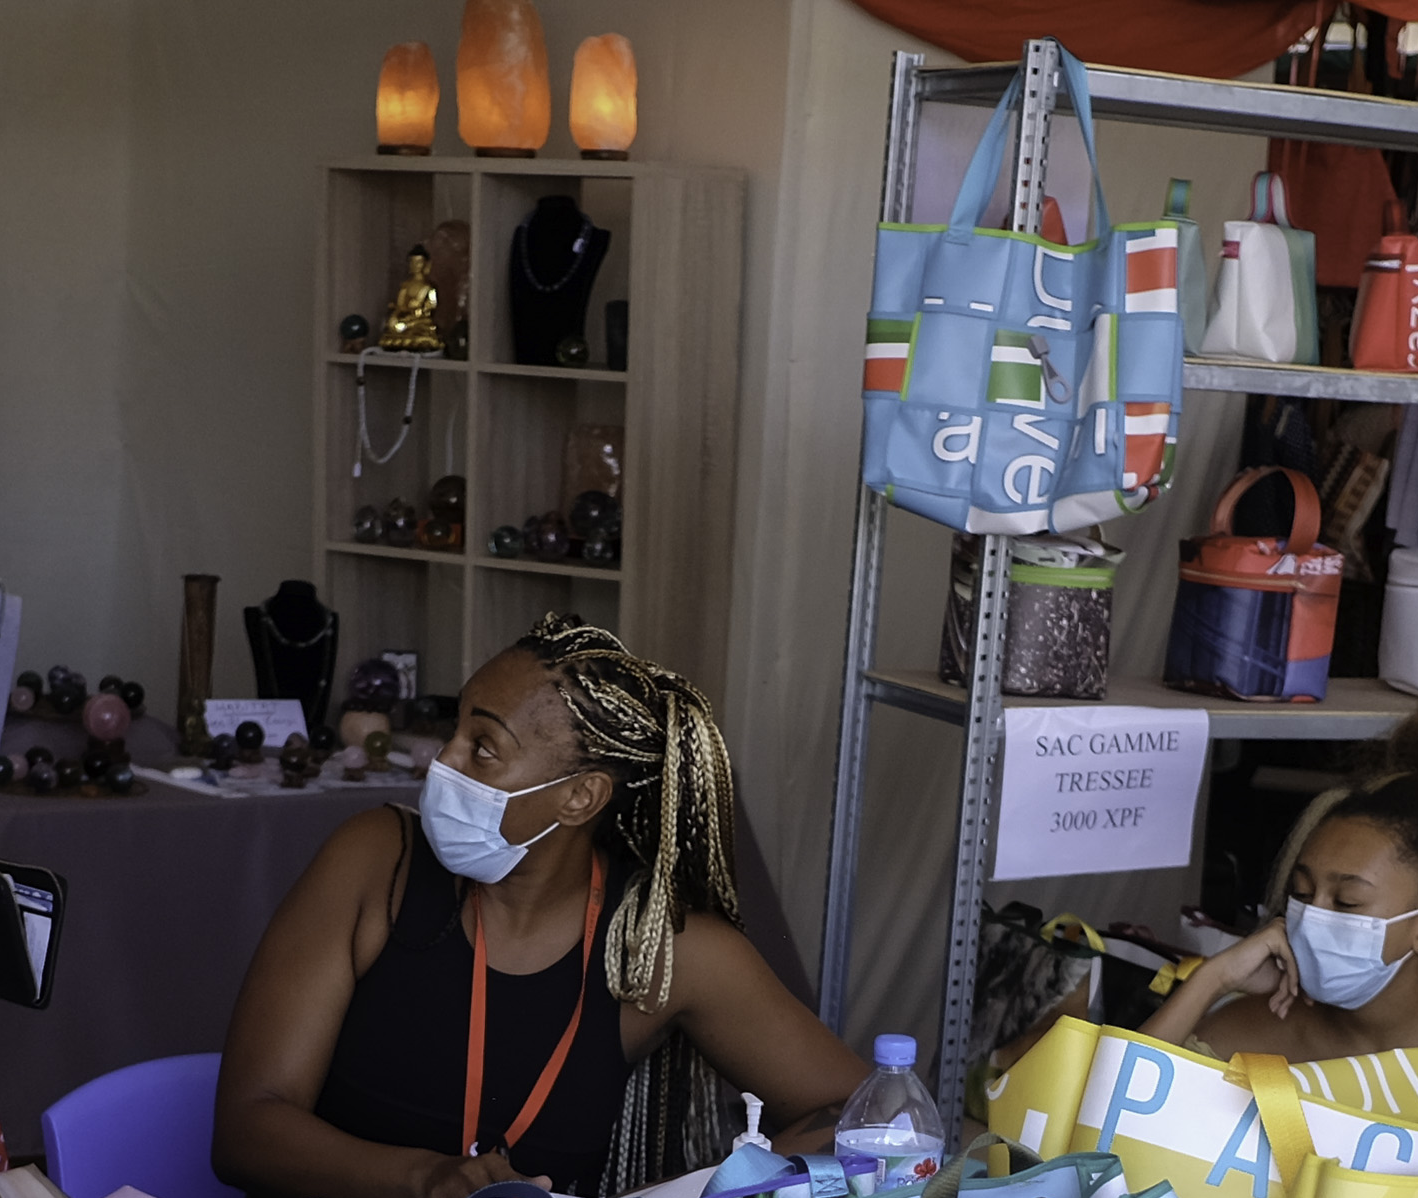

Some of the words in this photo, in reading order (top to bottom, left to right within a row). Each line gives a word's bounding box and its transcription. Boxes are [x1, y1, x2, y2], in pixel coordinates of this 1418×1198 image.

[1035, 734, 1083, 757] SAC
[1089, 730, 1180, 755] GAMME
[1054, 768, 1154, 793] TRESSEE
[1050, 809, 1098, 833] 3000
[1102, 807, 1146, 830] XPF
